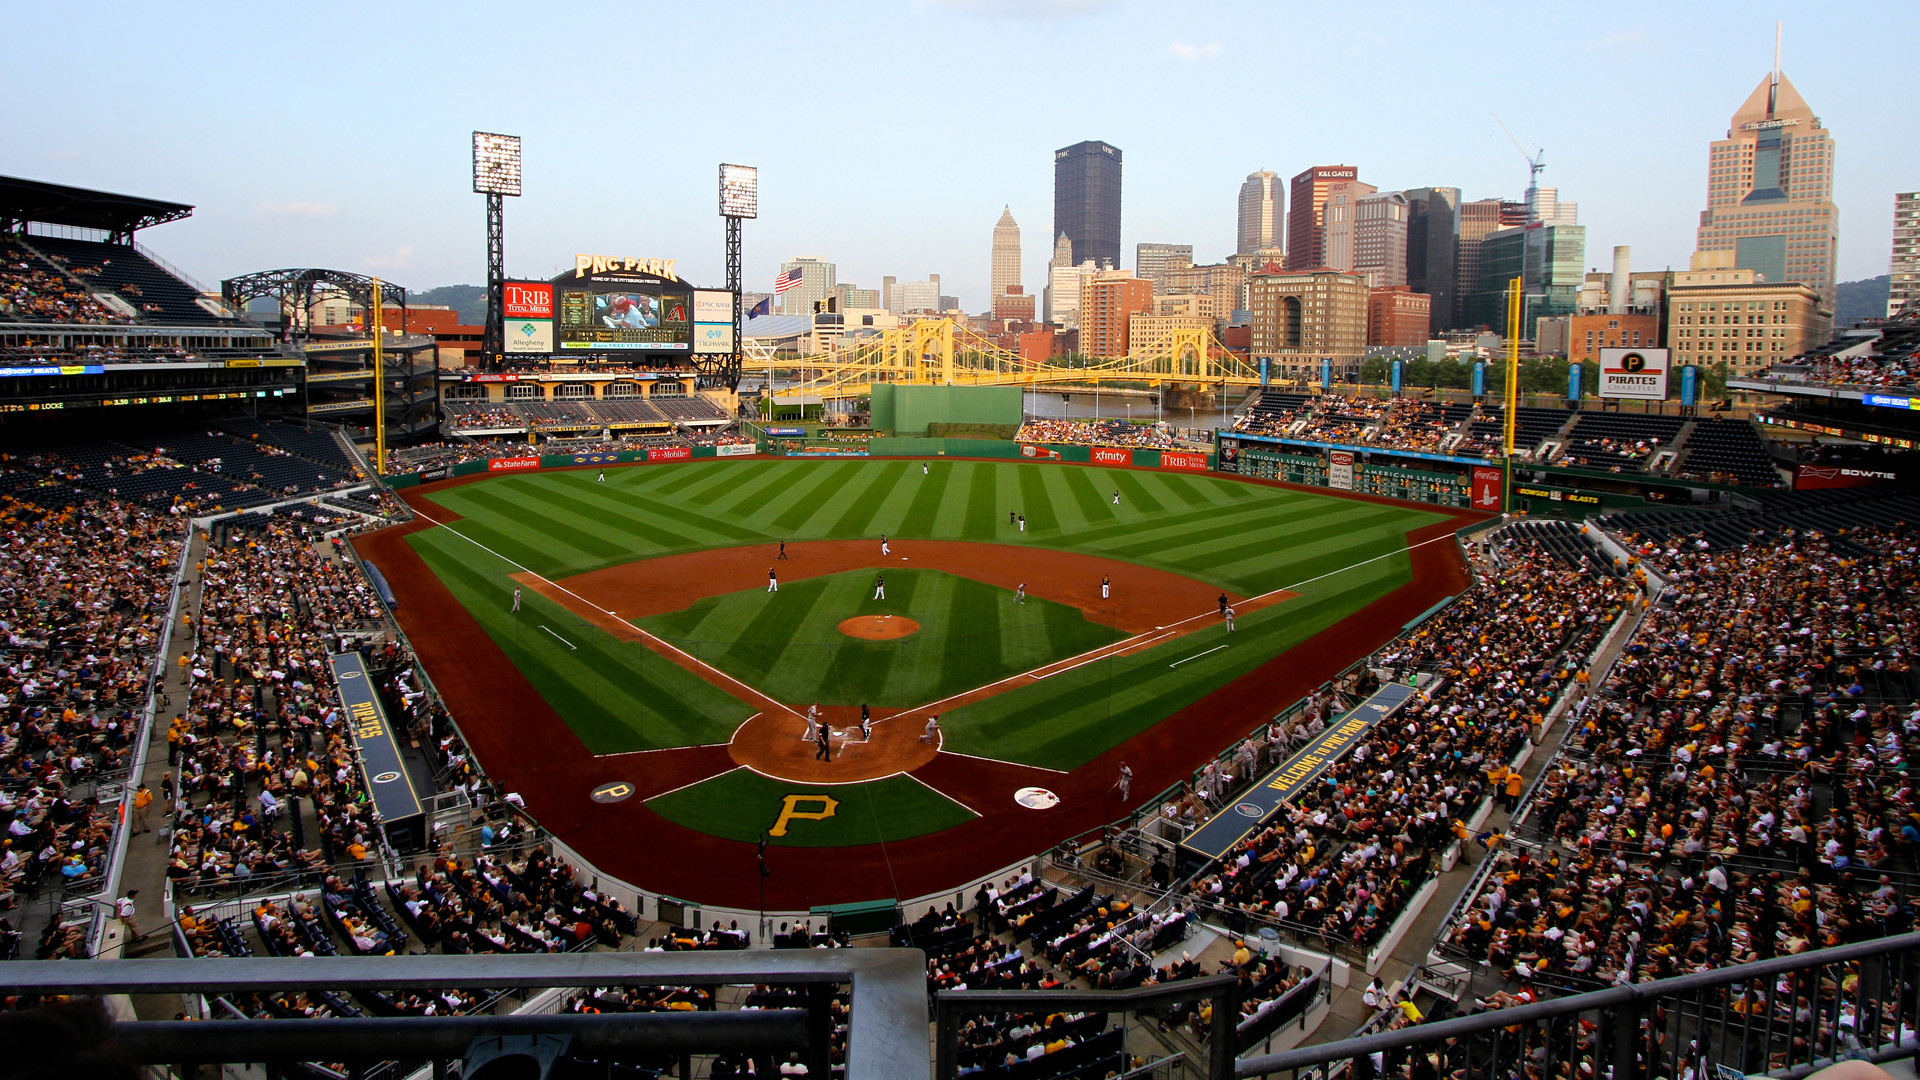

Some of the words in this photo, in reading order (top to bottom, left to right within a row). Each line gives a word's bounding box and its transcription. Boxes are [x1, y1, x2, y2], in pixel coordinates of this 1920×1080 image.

[1103, 145, 1114, 156] UPMC
[1332, 170, 1353, 178] GATES
[575, 253, 620, 279] PNC
[624, 256, 678, 283] PARK
[506, 286, 550, 305] TRIB
[507, 304, 529, 312] TOTAL
[529, 305, 550, 313] MEDIA
[513, 339, 545, 347] Allegheny
[495, 354, 503, 364] P
[1628, 357, 1640, 370] P
[1608, 376, 1657, 385] PIRATES
[41, 402, 64, 410] LOCKE
[1095, 450, 1126, 463] xfinity
[1161, 454, 1187, 467] TRIB
[1246, 453, 1285, 463] NATIONAL
[1286, 458, 1317, 467] LEAGUE
[1331, 454, 1351, 462] GetGo
[1364, 469, 1414, 480] AMERICAN
[1416, 475, 1457, 486] LEAGUE
[1840, 468, 1896, 480] BOWTIE
[1519, 488, 1550, 498] BOWSER
[1568, 494, 1599, 504] BLASTS
[1336, 718, 1369, 737] PARK
[1320, 733, 1350, 750] PNC
[1313, 747, 1333, 757] TO
[1267, 754, 1325, 792] WELCOME
[595, 784, 630, 797] P
[767, 793, 841, 838] P
